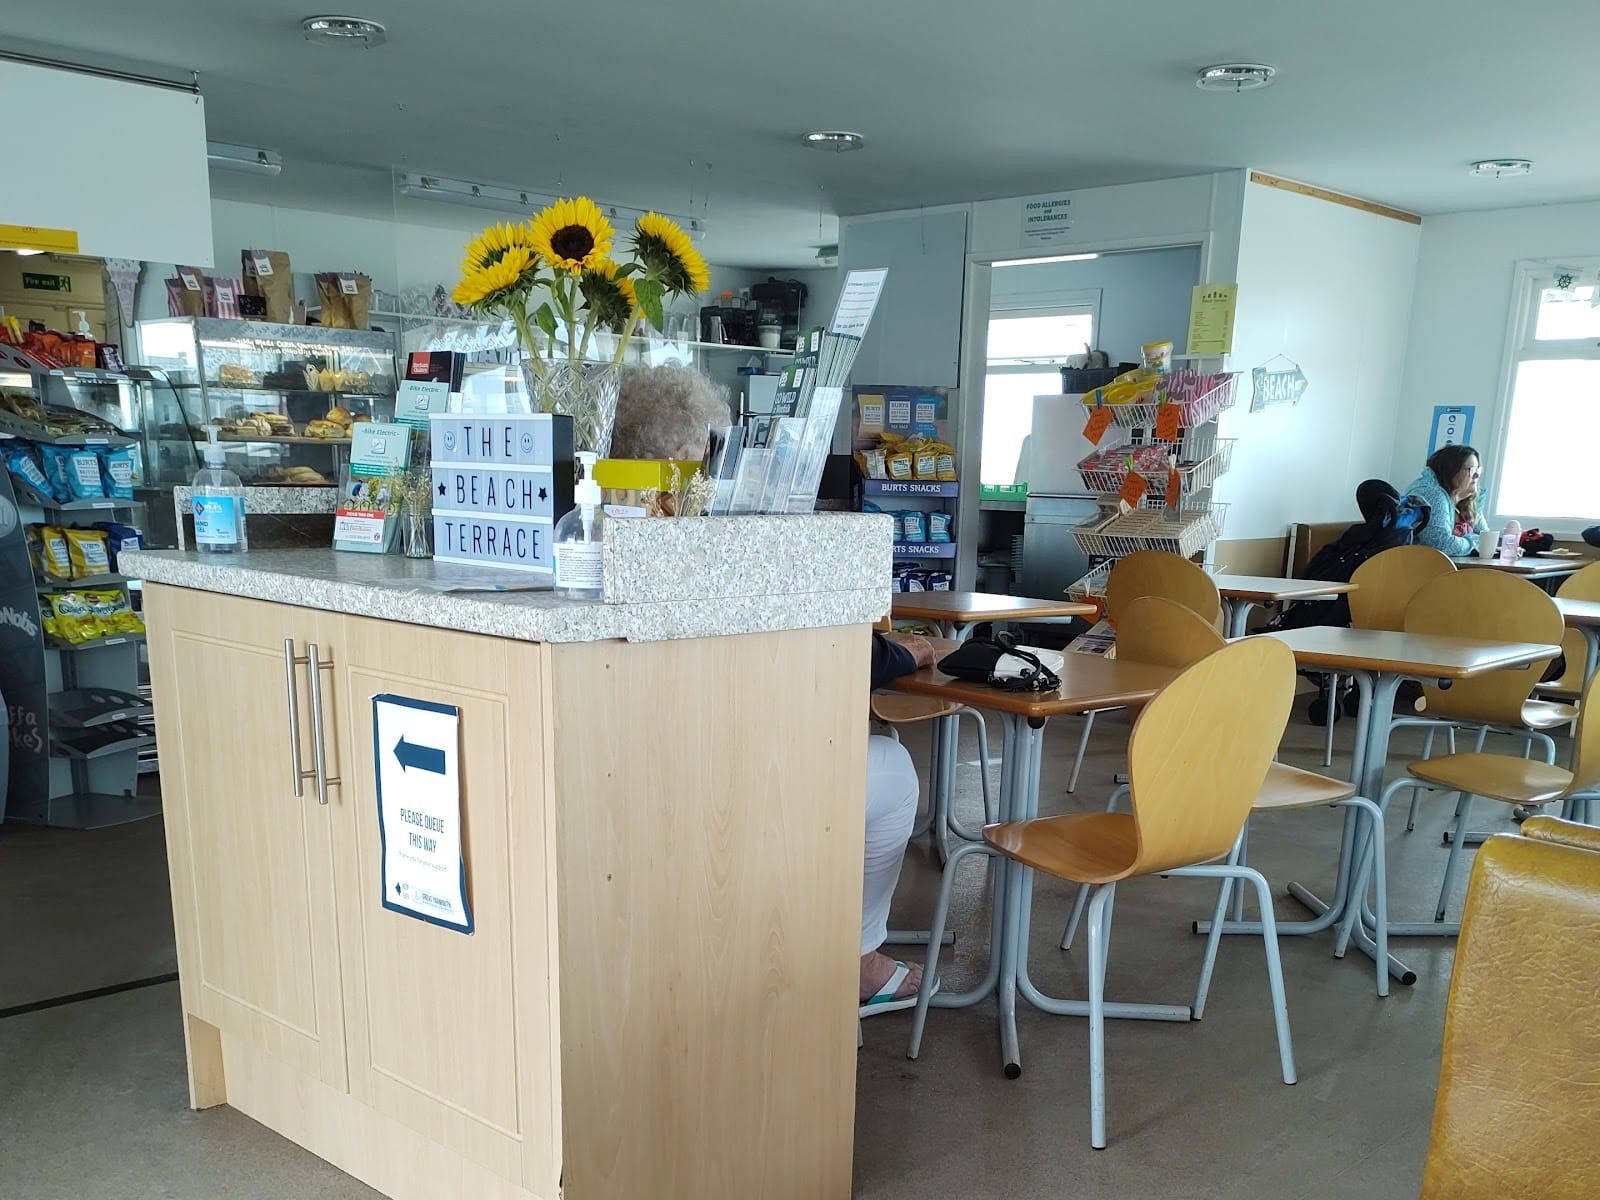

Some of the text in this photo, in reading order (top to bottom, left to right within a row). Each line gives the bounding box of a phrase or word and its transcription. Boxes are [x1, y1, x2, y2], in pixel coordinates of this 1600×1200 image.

[1042, 199, 1071, 208] ALLERGIES
[1028, 213, 1068, 223] INTOLERANCES
[25, 277, 40, 286] Fire
[1263, 374, 1295, 400] BEACH
[464, 426, 513, 457] THE
[456, 475, 533, 510] BEACH
[881, 484, 941, 493] BURTS SNACKS
[445, 523, 541, 560] TERRACE
[908, 545, 940, 553] SNACKS
[0, 607, 38, 638] Nobs
[9, 705, 37, 726] ffa
[400, 808, 445, 834] PLEASE QUEUE
[409, 832, 437, 853] THIS WAY
